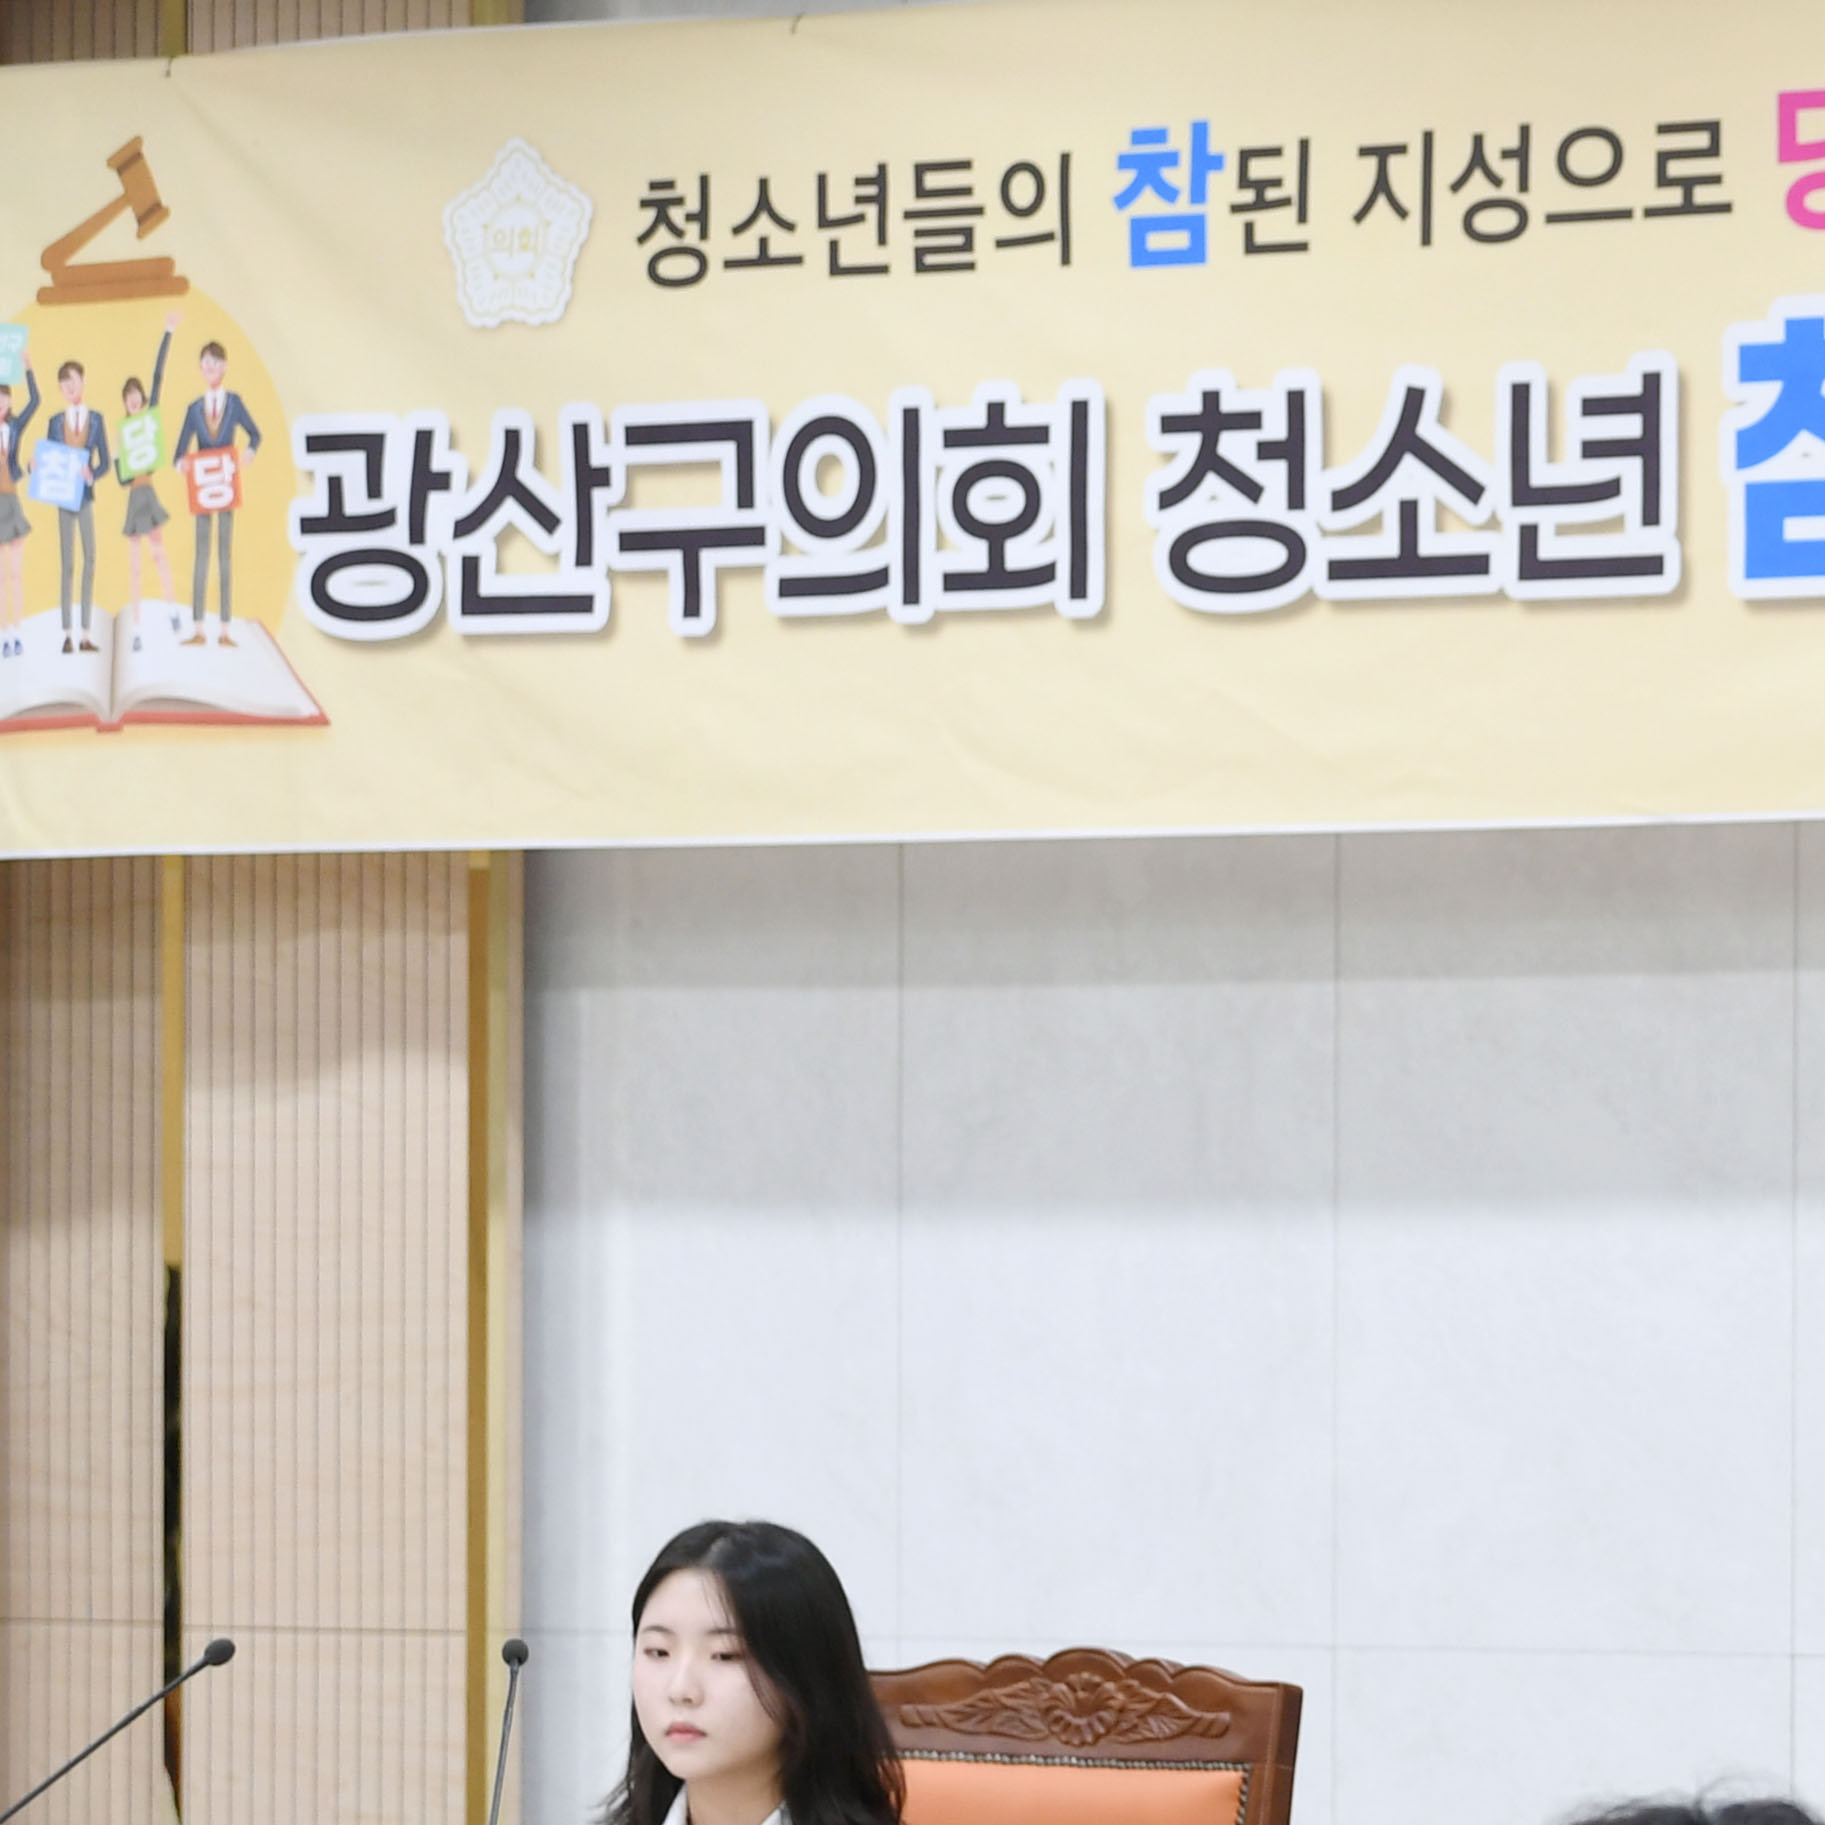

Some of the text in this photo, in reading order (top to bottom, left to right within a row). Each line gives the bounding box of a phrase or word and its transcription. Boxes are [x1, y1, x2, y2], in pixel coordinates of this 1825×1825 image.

[636, 151, 1071, 288] 청소년들의
[1112, 119, 1311, 268] 참된
[1352, 118, 1734, 247] 지성으로
[121, 417, 158, 471] 당
[192, 452, 236, 509] 당
[297, 396, 1092, 624] 광산구의회
[1157, 370, 1666, 596] 청소년
